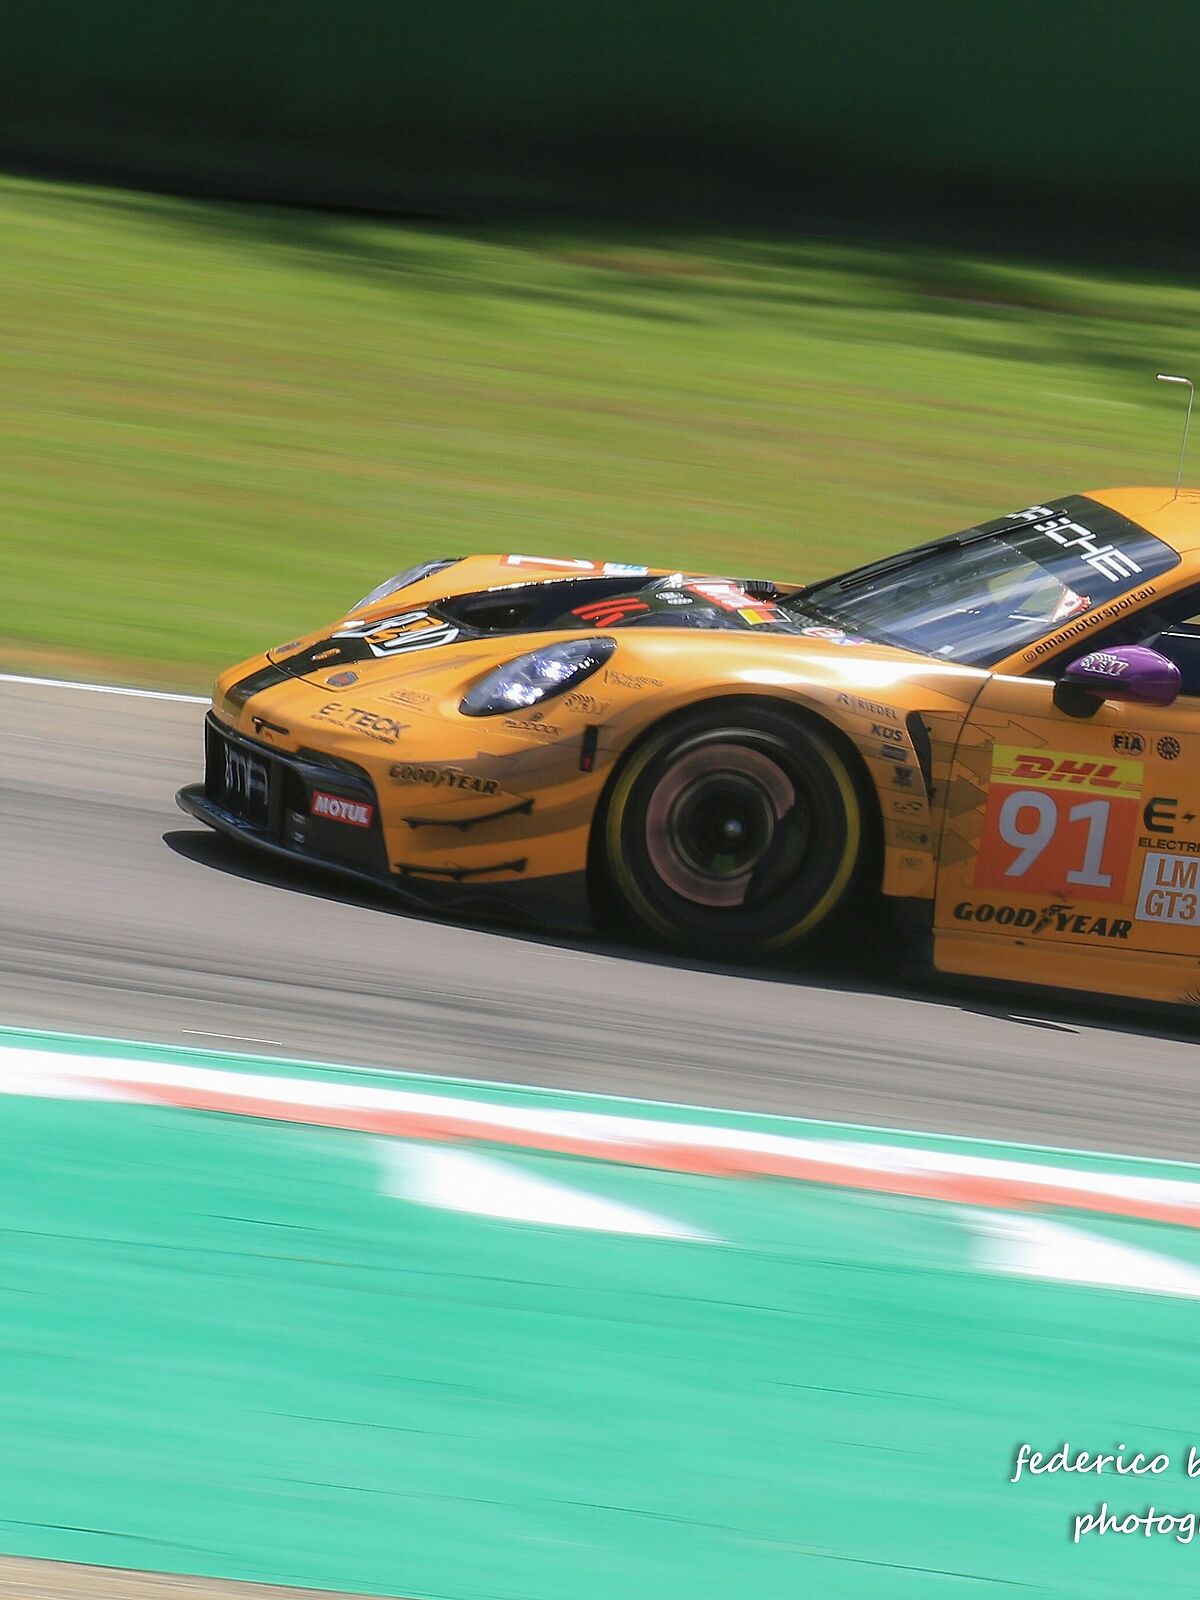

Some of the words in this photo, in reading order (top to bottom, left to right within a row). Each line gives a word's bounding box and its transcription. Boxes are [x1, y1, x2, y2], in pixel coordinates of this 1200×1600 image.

[857, 698, 897, 720] RIEDEL
[1114, 734, 1142, 752] FIA
[1011, 754, 1122, 789] DHL
[314, 795, 368, 824] MOTUL
[999, 790, 1112, 888] 91
[1155, 858, 1199, 889] LM
[1145, 889, 1197, 921] GT3
